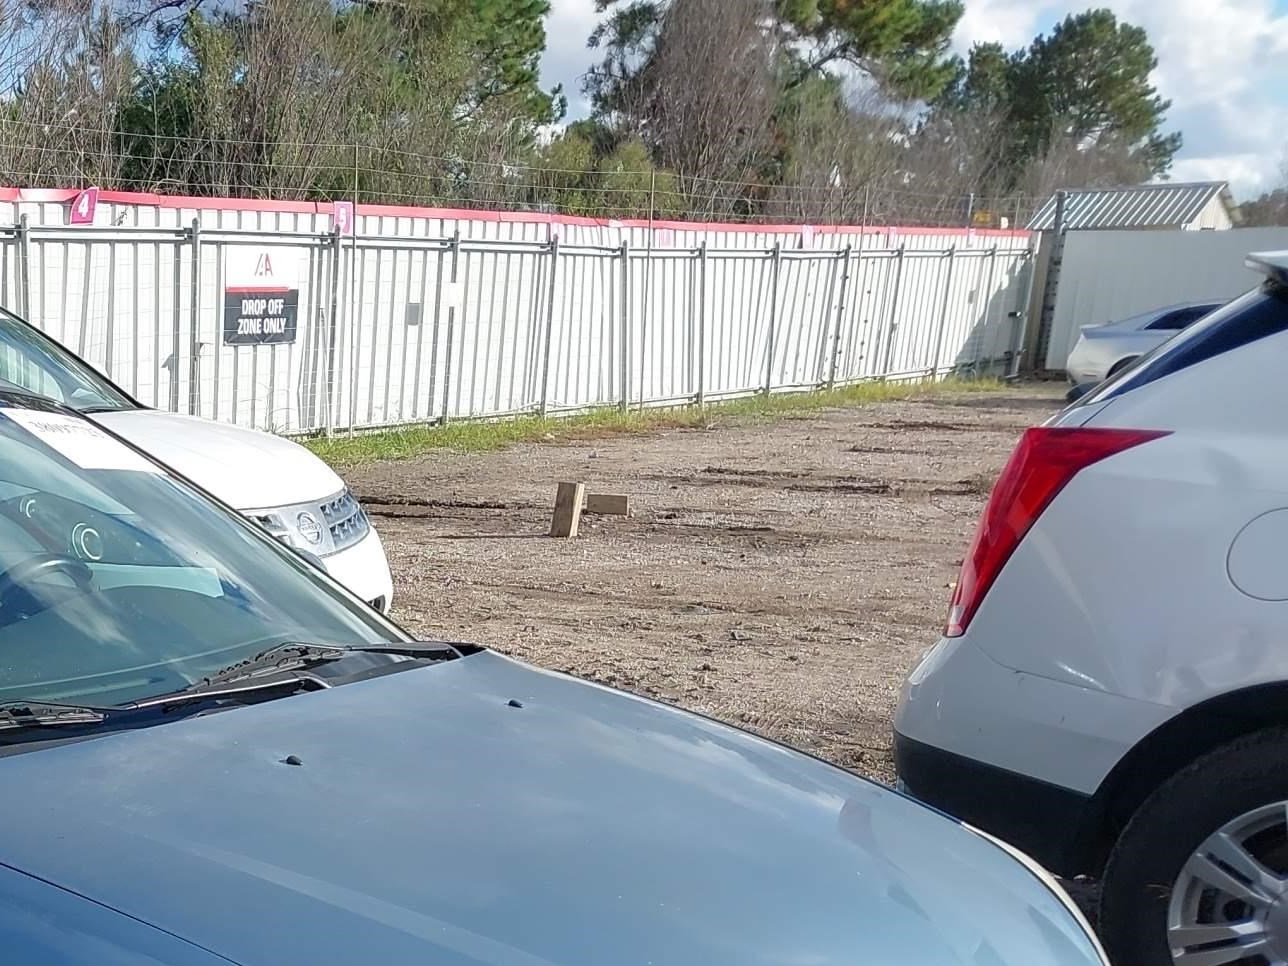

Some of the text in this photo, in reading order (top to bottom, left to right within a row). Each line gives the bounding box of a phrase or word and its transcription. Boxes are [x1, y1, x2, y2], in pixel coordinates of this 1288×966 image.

[78, 193, 89, 218] 4
[242, 298, 284, 315] DROP OFF
[237, 317, 287, 335] ZONE ONLY
